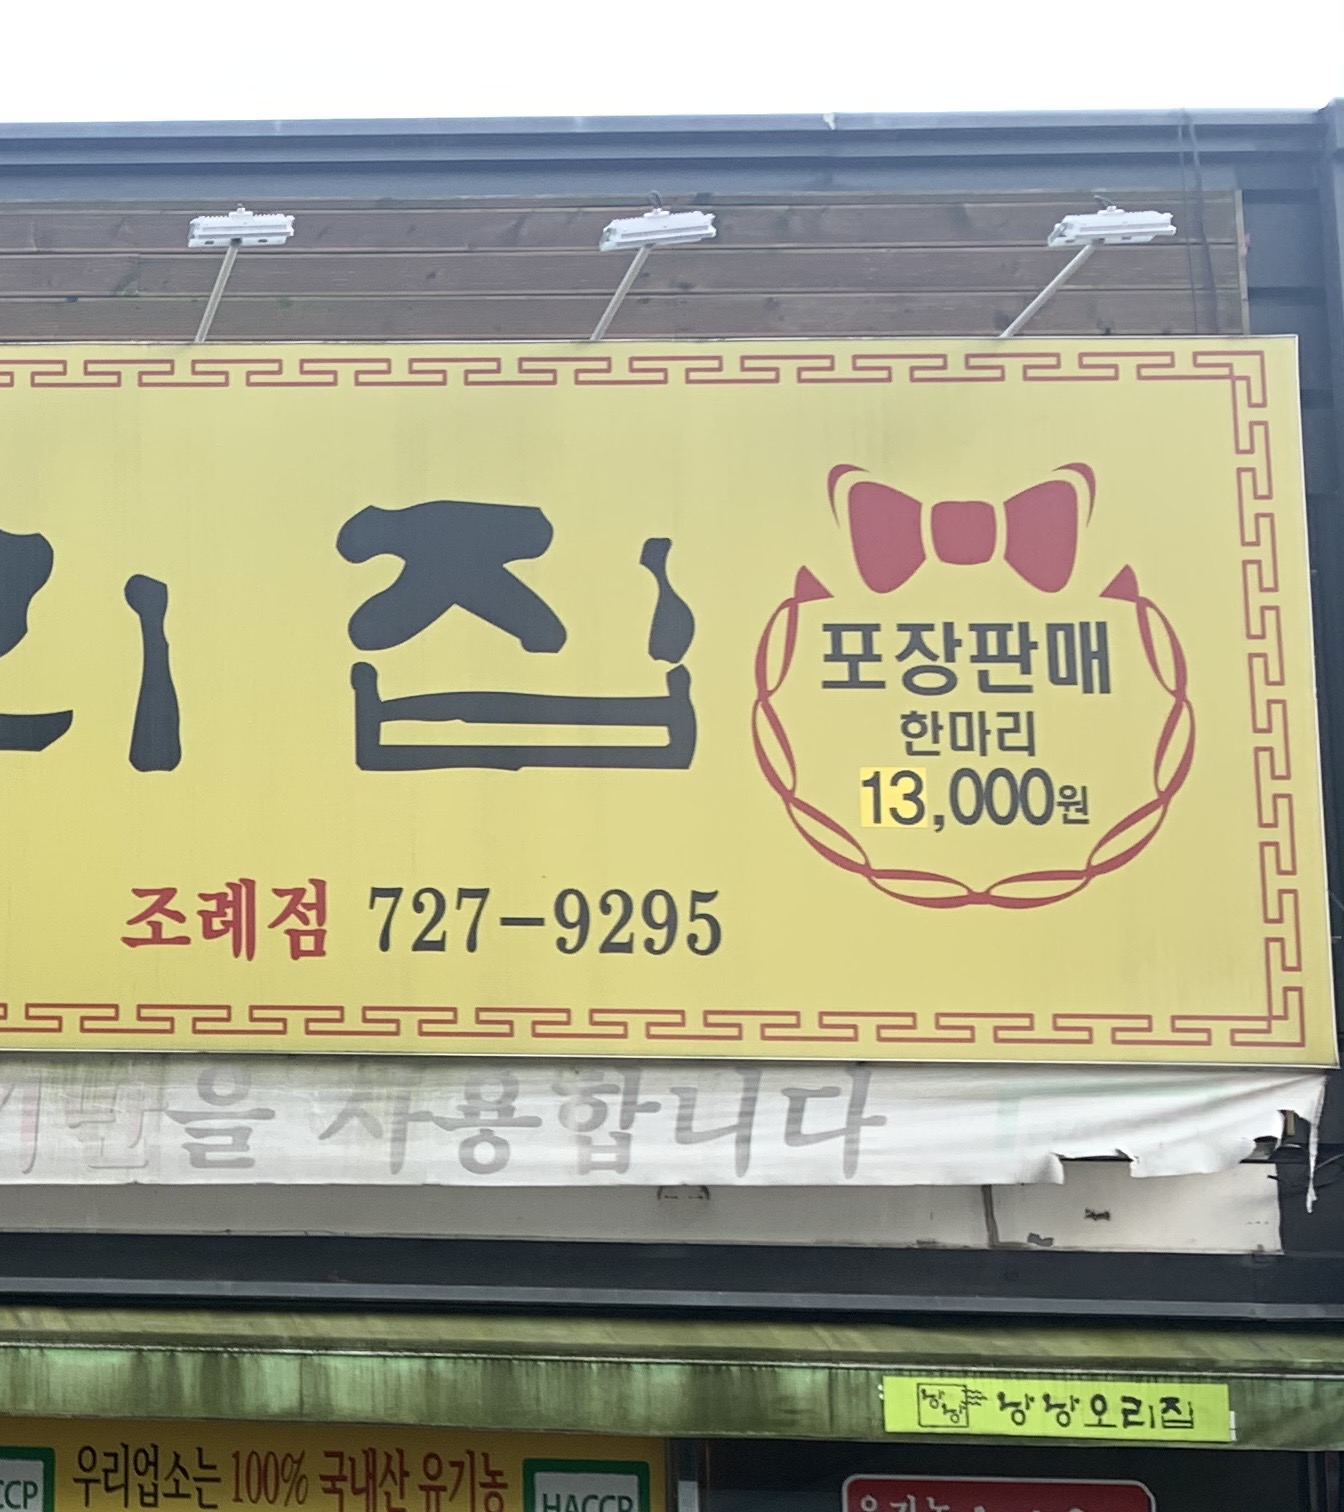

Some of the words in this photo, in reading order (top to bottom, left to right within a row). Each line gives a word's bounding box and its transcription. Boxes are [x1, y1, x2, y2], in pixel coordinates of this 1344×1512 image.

[821, 621, 1111, 696] 포장판매
[900, 711, 1036, 758] 한마리
[121, 878, 327, 961] 조례점
[368, 886, 723, 956] 727-9295
[318, 1060, 887, 1180] 사용합니다
[73, 1444, 221, 1510] 우리업소는
[230, 1448, 309, 1506] 100%
